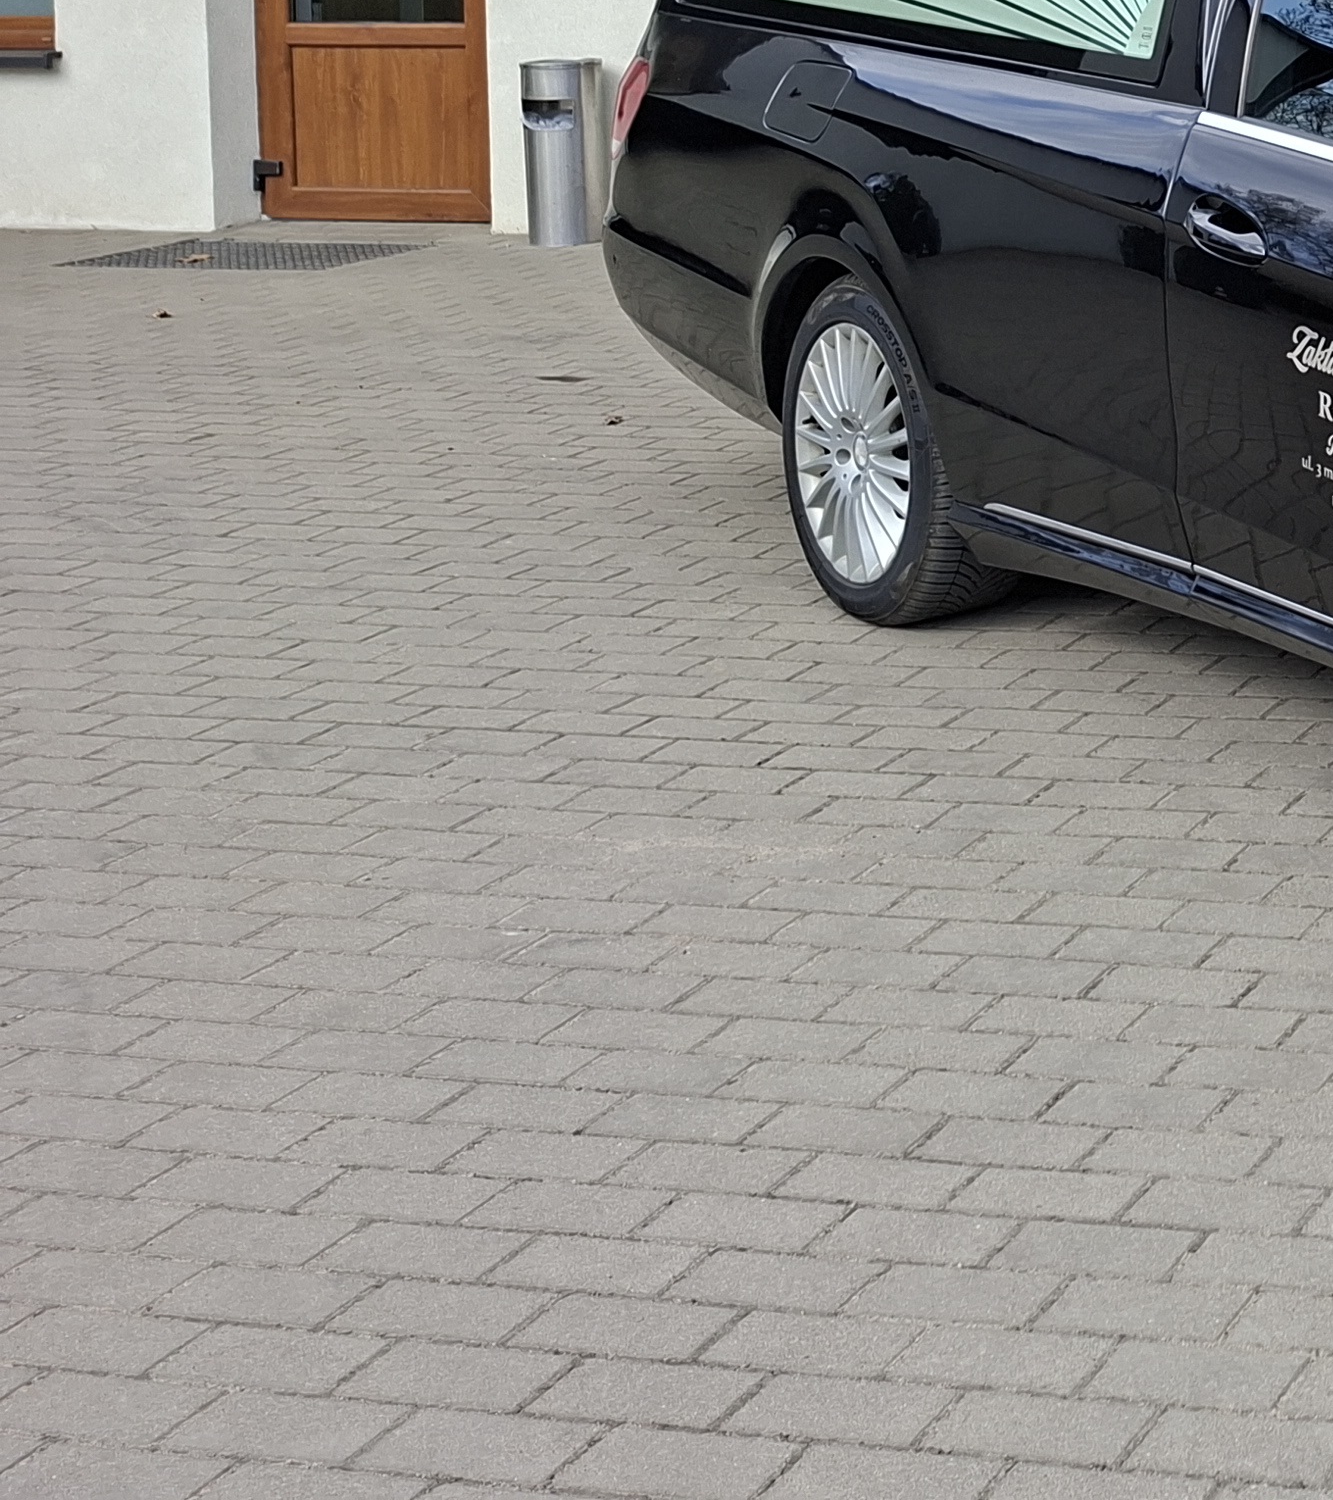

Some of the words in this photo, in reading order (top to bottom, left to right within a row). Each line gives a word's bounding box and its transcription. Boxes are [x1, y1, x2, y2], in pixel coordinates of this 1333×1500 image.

[866, 304, 908, 368] CROSSTOP
[1301, 455, 1314, 472] ul.
[1315, 463, 1322, 478] 3
